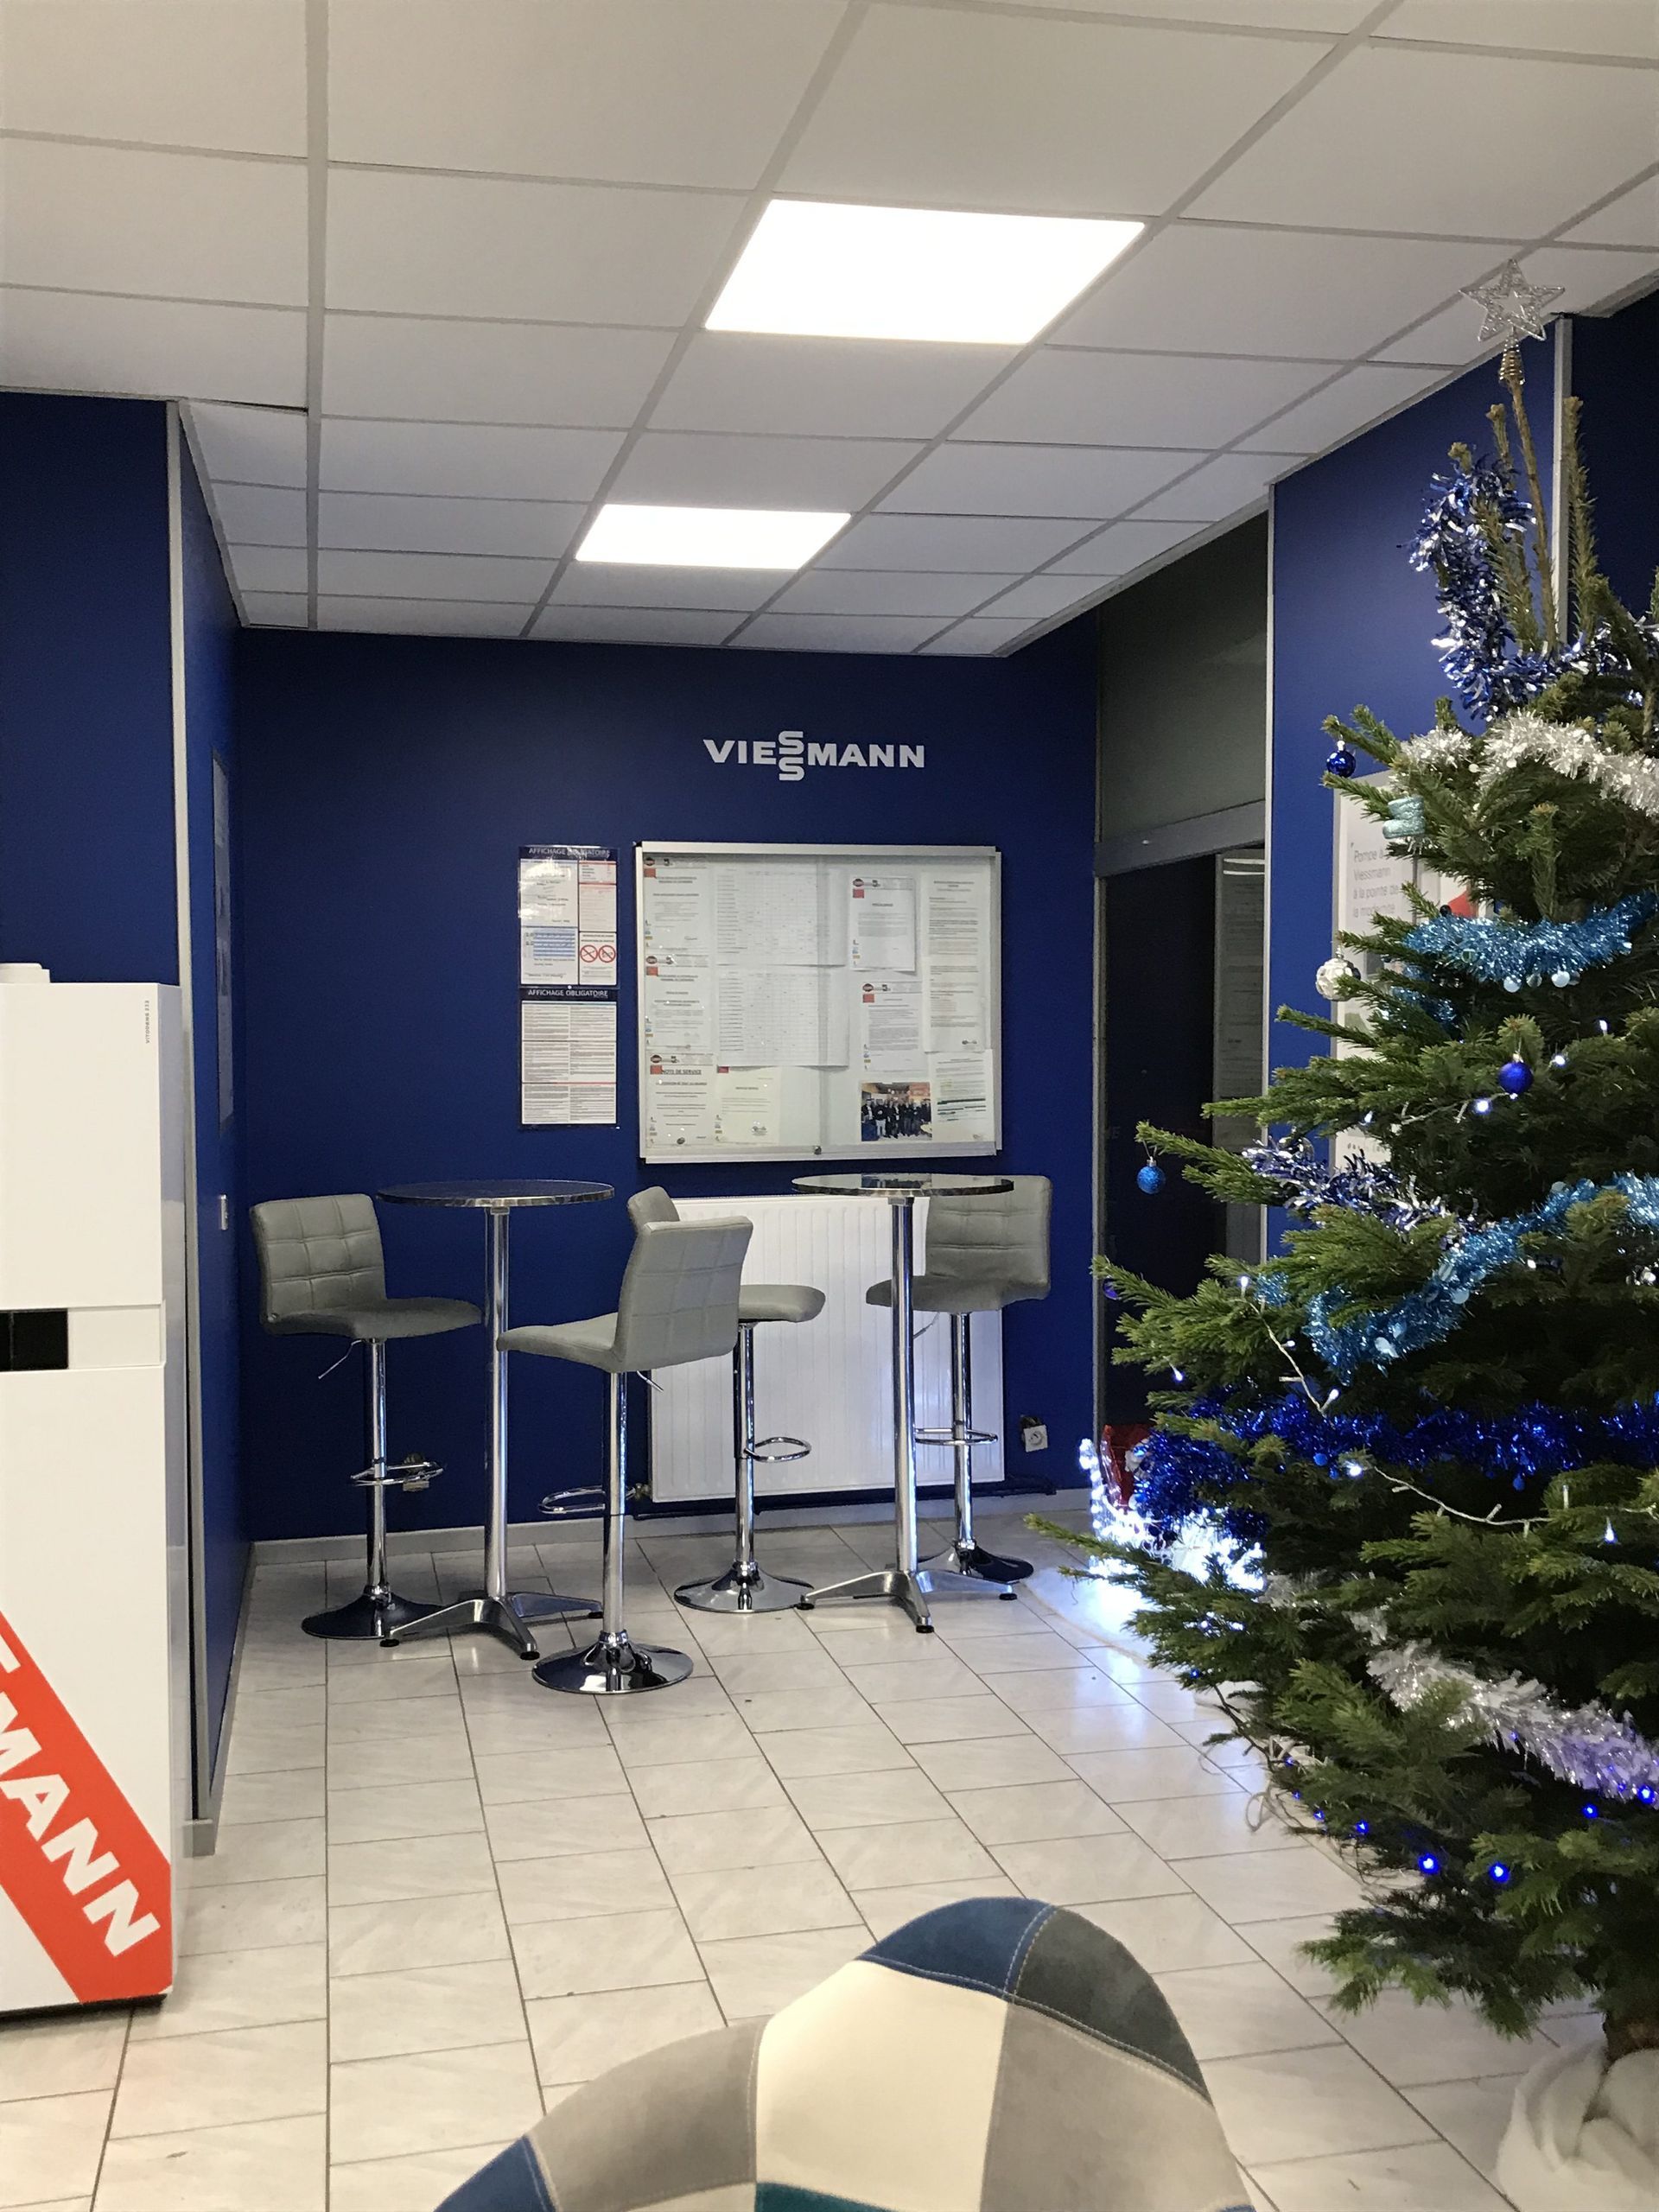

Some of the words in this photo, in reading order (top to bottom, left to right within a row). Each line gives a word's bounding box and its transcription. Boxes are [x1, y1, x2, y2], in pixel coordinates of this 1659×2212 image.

[702, 730, 925, 781] VIESSMANN
[1354, 849, 1377, 862] Pompe
[0, 1630, 162, 1958] MANN
